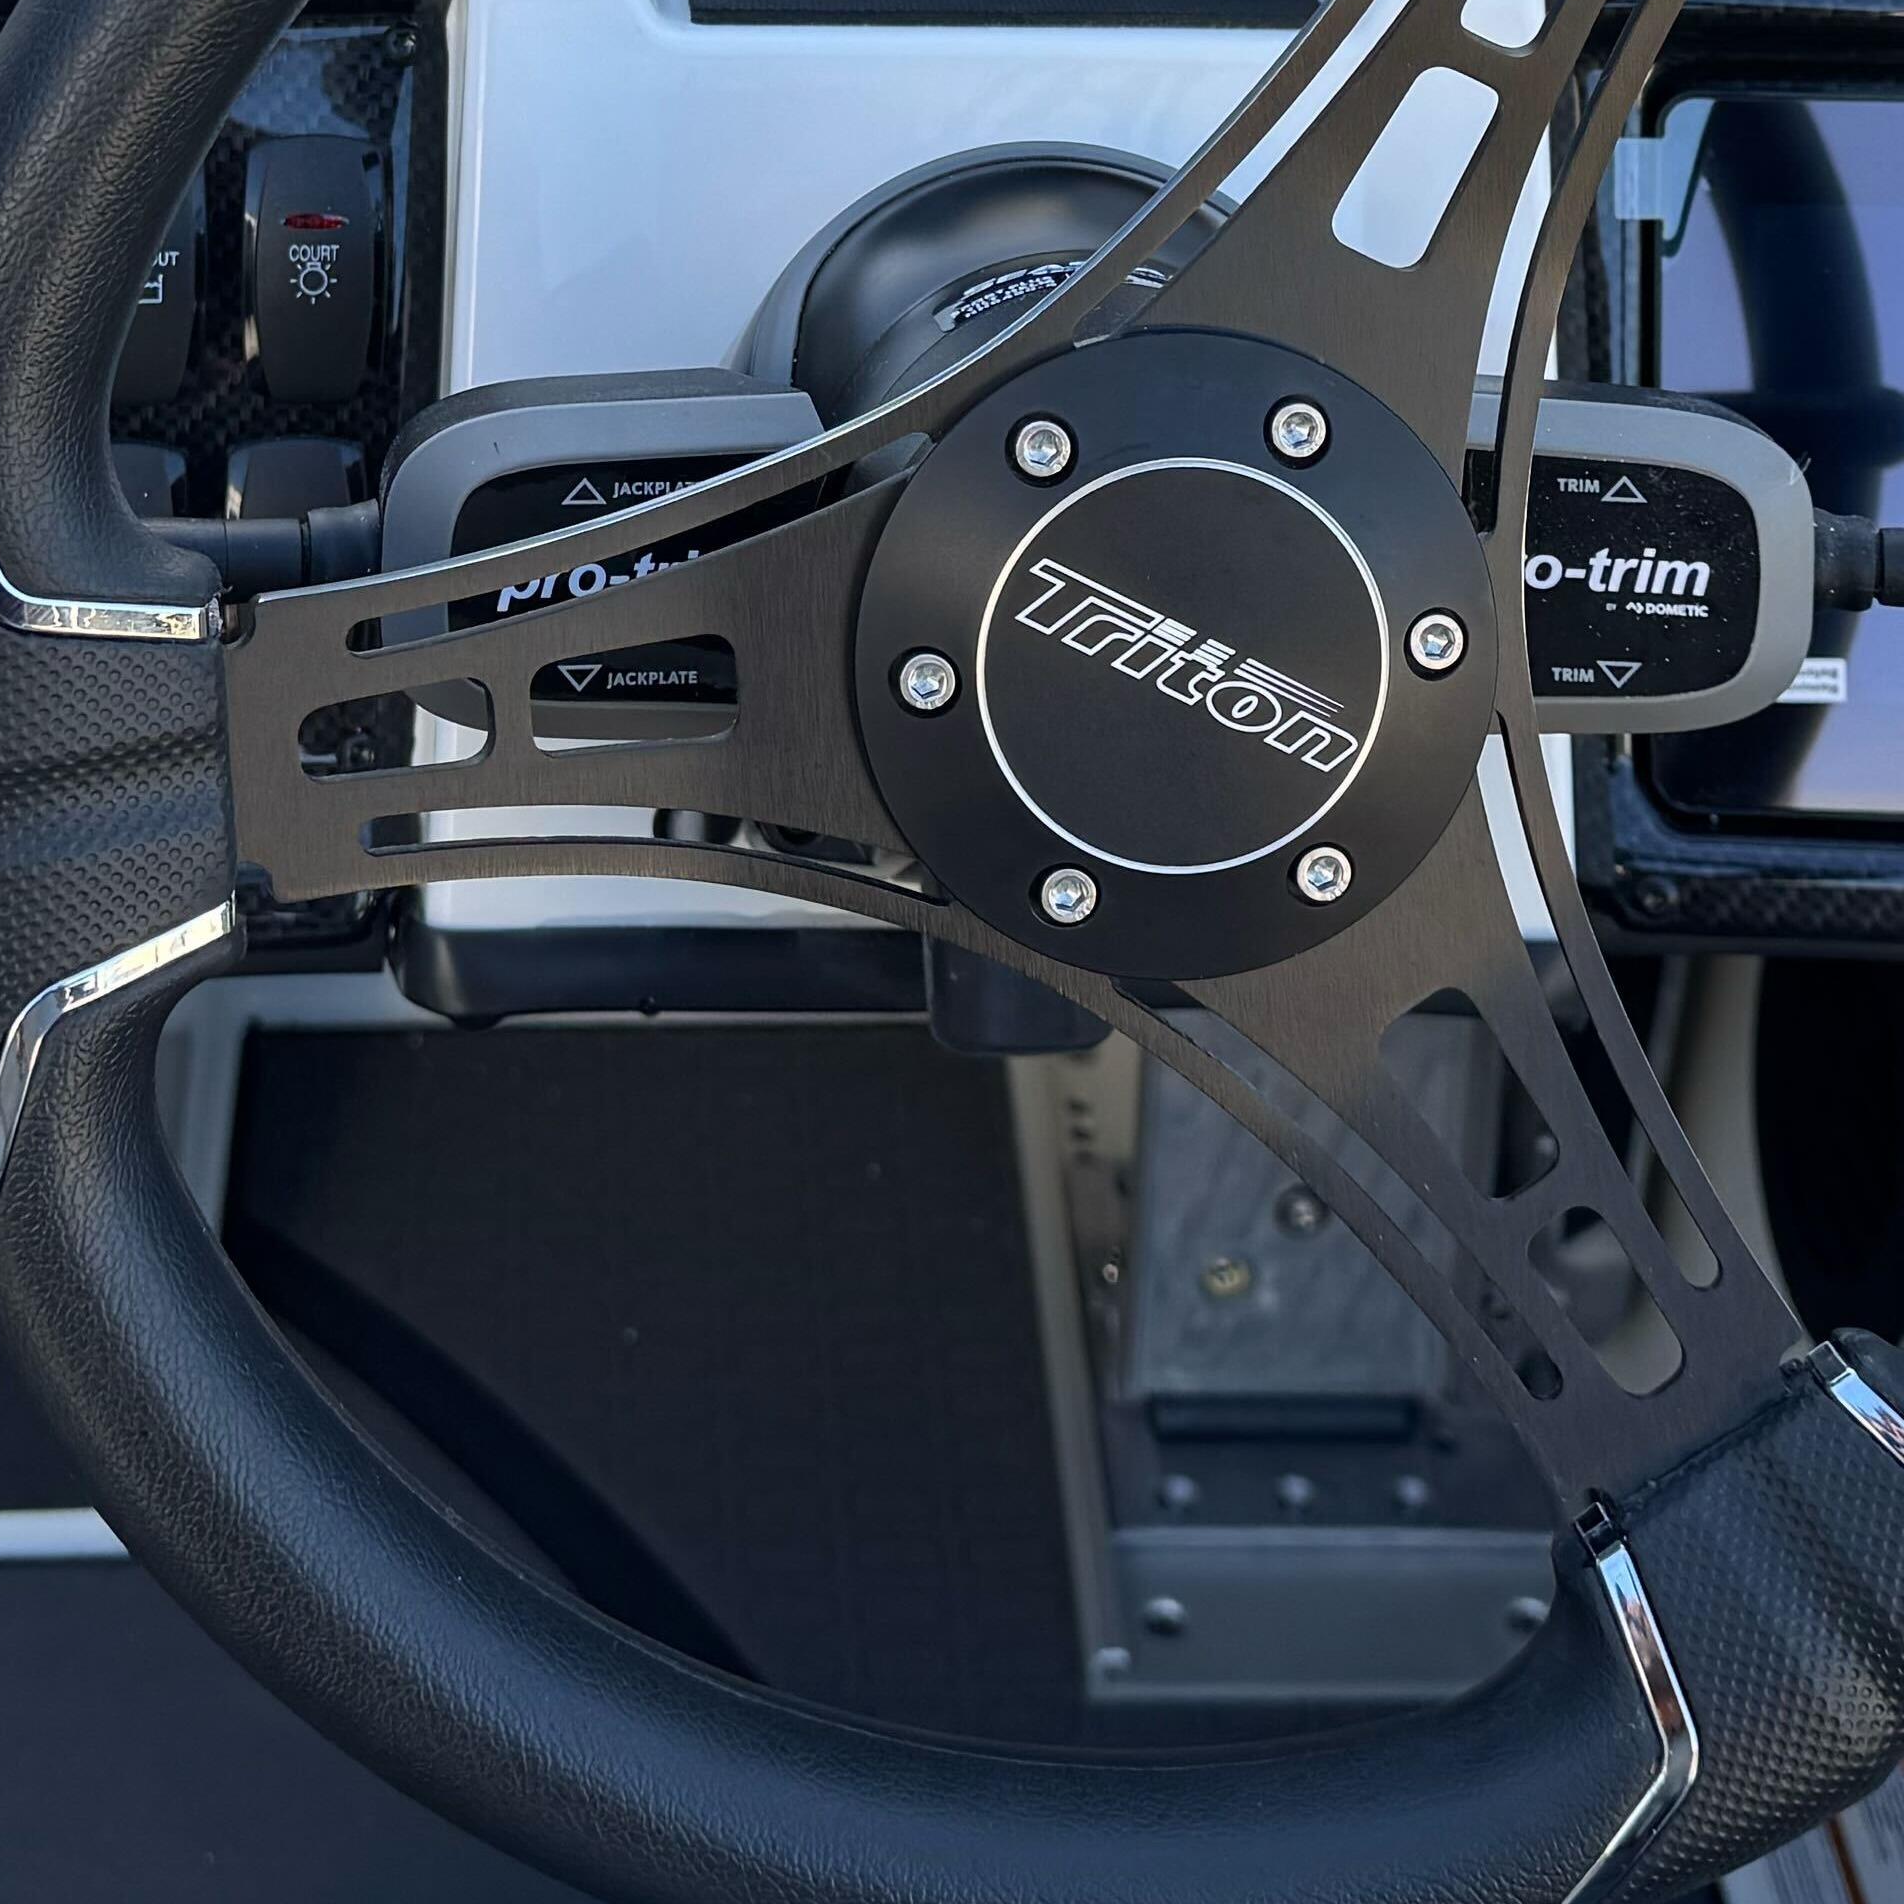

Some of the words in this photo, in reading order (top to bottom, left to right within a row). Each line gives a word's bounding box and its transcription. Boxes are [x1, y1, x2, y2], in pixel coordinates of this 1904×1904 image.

[289, 244, 340, 263] COURT
[612, 481, 698, 499] JACKPLA
[1557, 477, 1600, 494] TRIM
[496, 549, 701, 613] pro-t
[1524, 547, 1712, 597] o-trim
[1645, 602, 1709, 617] DOMETIC
[1014, 557, 1359, 773] Triton
[607, 670, 699, 690] JACKPLATE
[1551, 667, 1595, 684] TRIM
